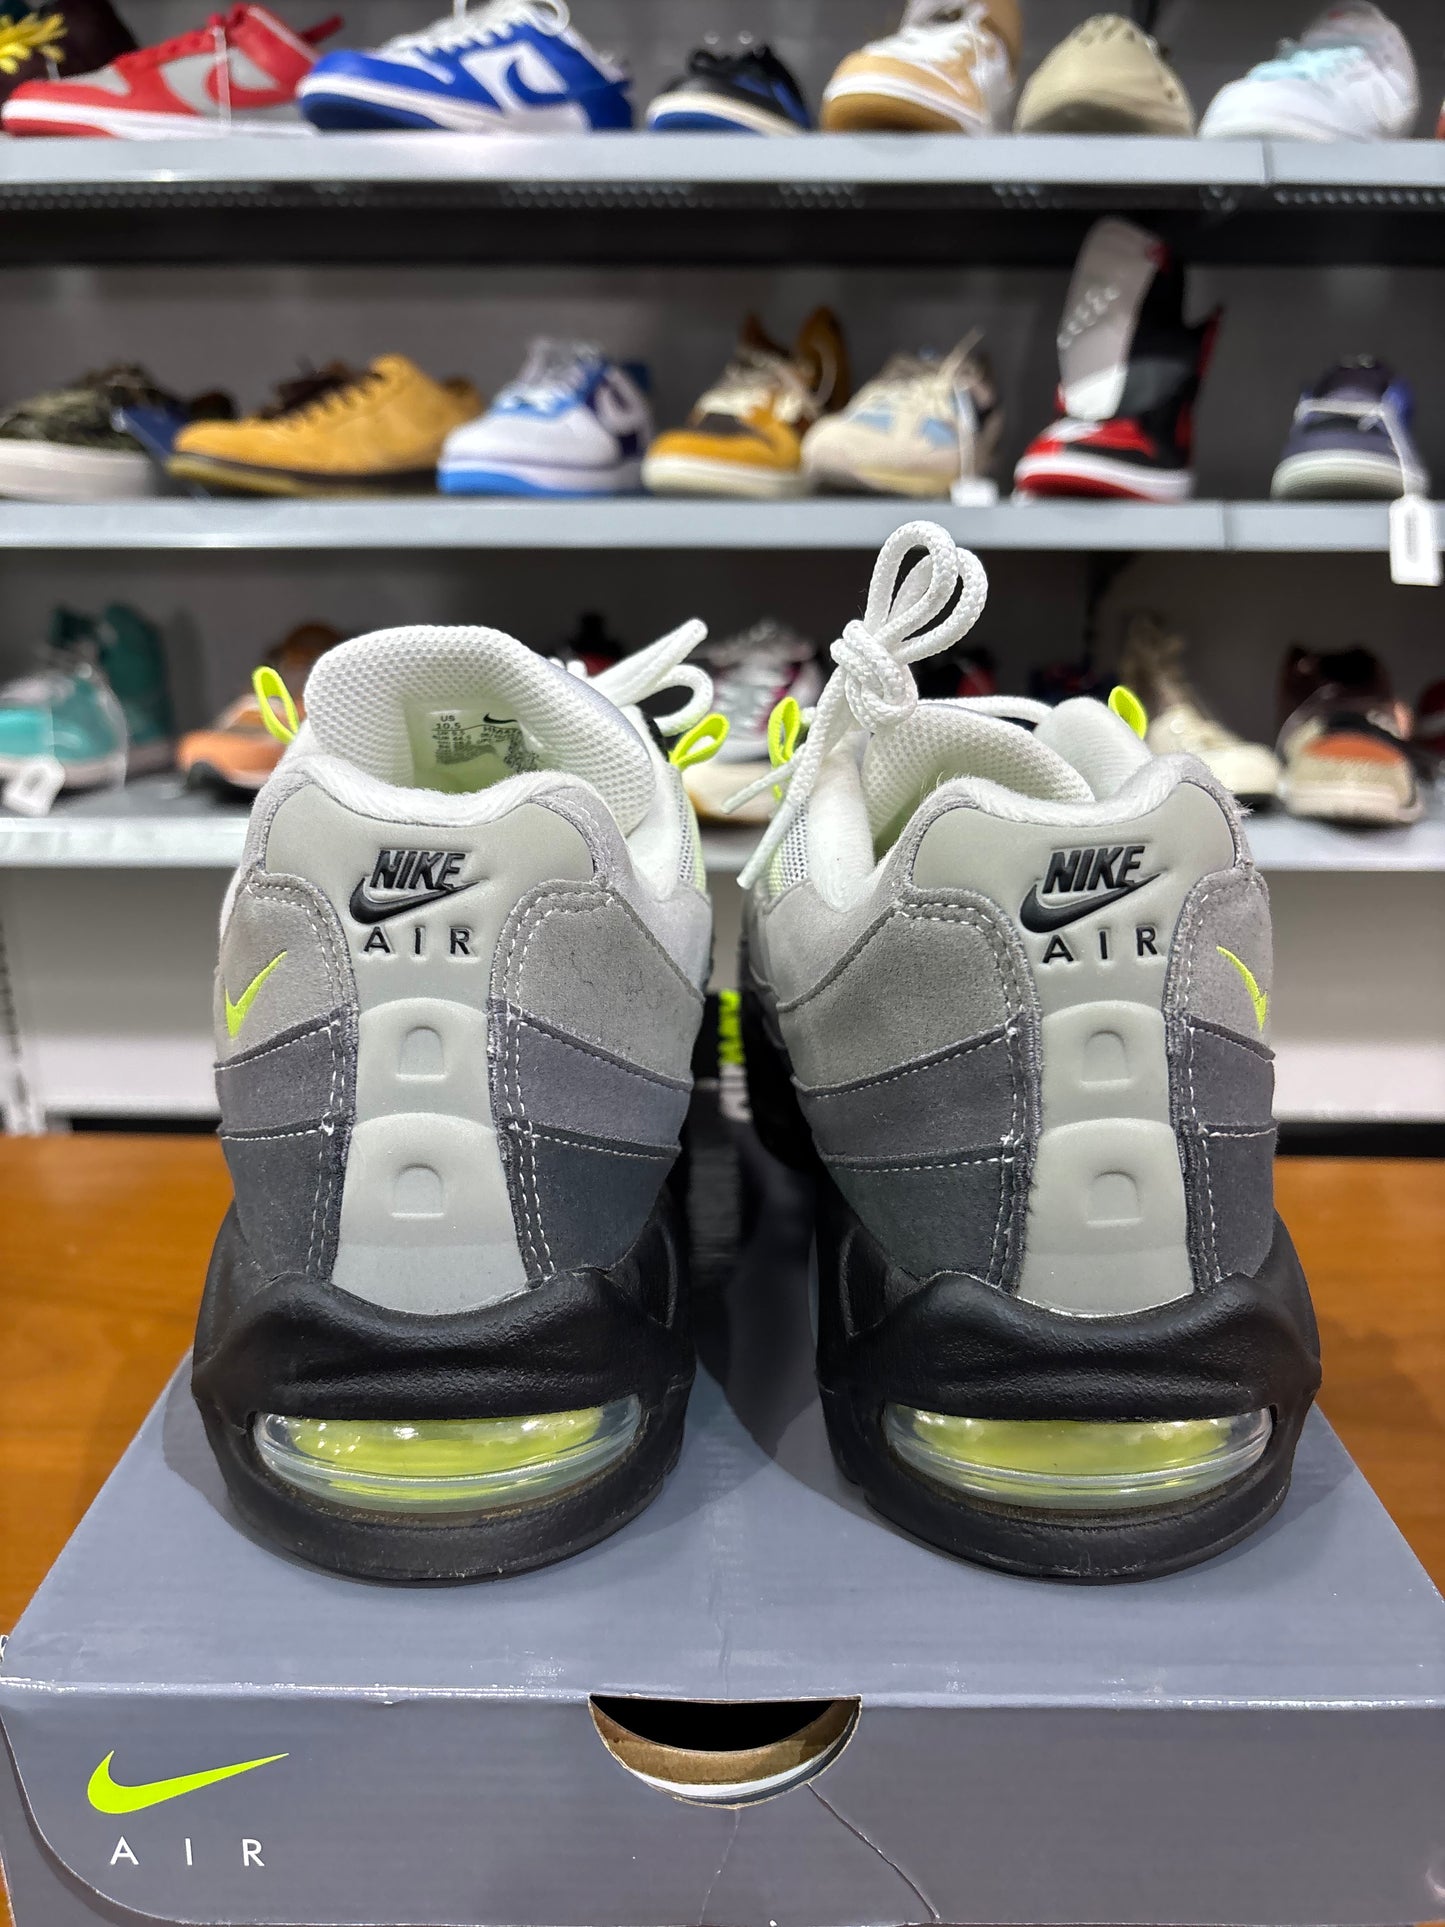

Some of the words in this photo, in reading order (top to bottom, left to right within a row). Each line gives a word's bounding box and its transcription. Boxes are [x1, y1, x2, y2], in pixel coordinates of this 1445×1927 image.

[369, 849, 467, 890] NIKE
[1042, 845, 1145, 894] NIKE
[363, 926, 471, 955] AIR
[1042, 927, 1158, 963] AIR
[110, 1836, 265, 1867] AIR
